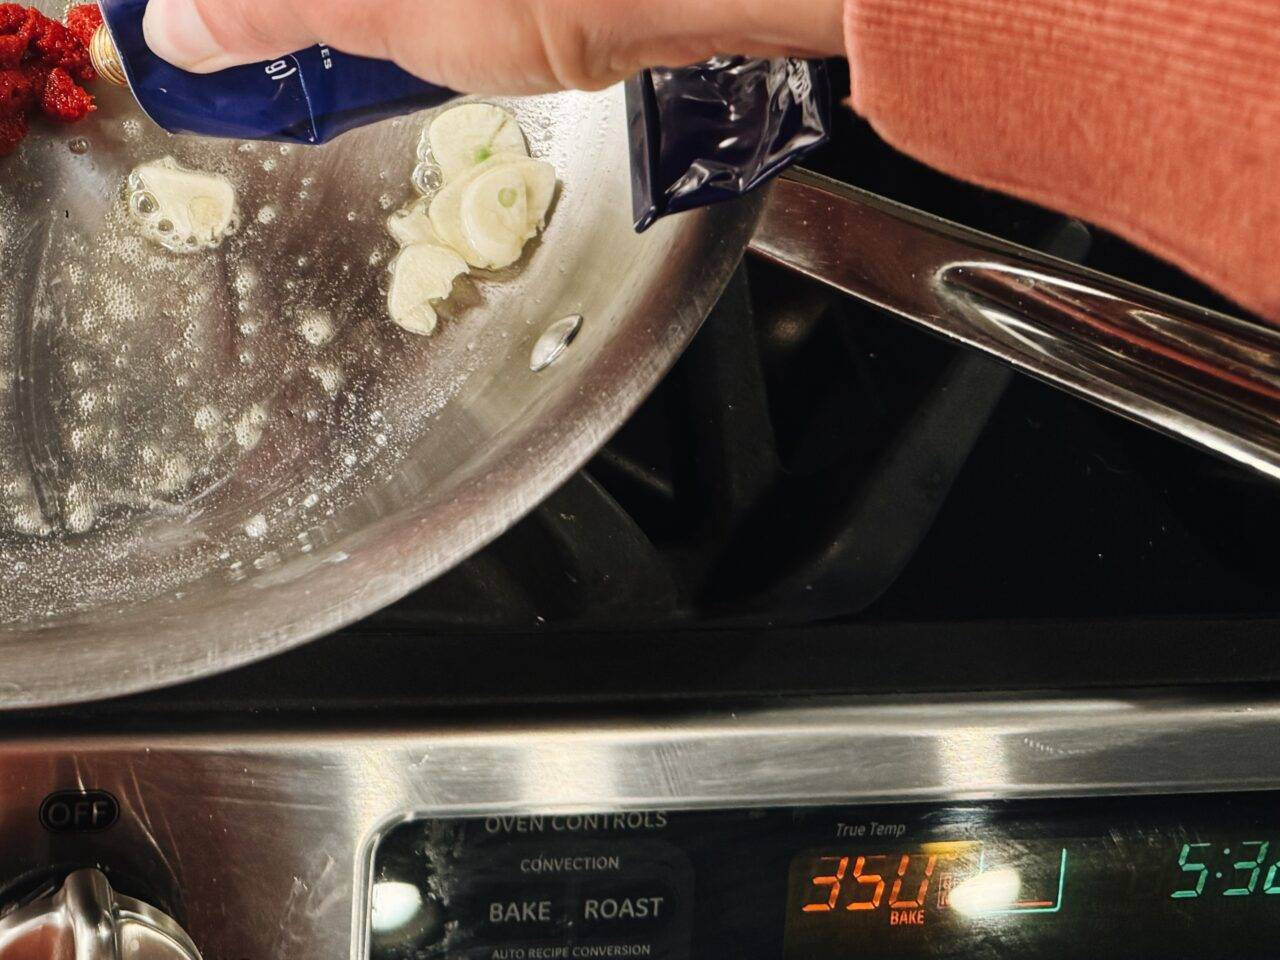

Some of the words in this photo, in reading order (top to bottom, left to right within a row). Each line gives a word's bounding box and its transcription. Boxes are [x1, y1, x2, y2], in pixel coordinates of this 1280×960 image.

[48, 801, 108, 827] OFF
[485, 814, 545, 833] OVEN
[551, 810, 668, 832] CONTROLS
[836, 822, 866, 838] True
[870, 821, 907, 838] Temp
[520, 855, 621, 874] CONVECTION
[802, 854, 938, 912] 350
[489, 901, 552, 923] BAKE
[583, 897, 664, 920] ROAST
[889, 909, 926, 926] BAKE
[492, 948, 526, 960] AUTO
[528, 947, 569, 960] RECIPE
[572, 944, 651, 958] CONVERSION
